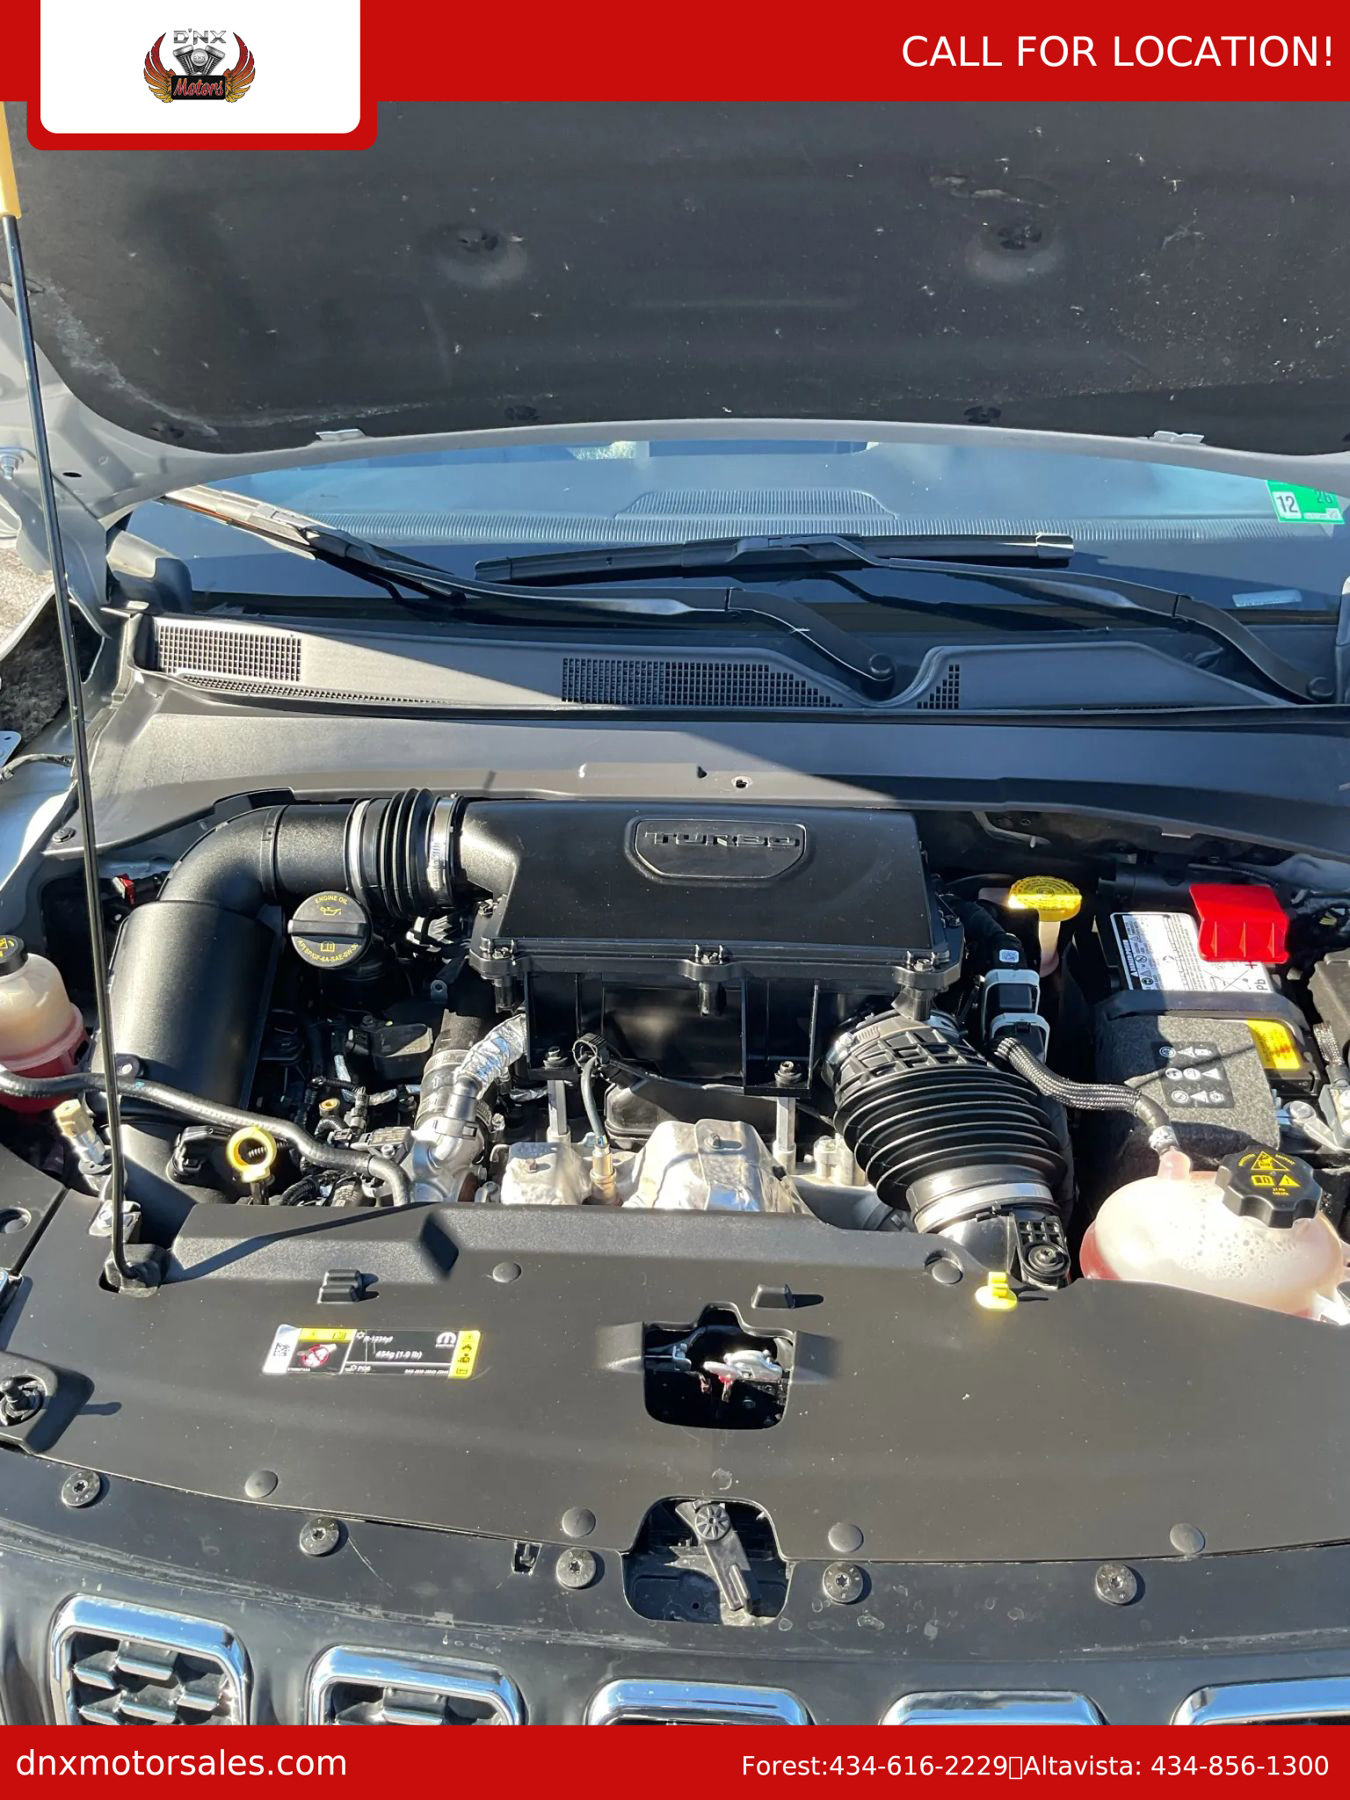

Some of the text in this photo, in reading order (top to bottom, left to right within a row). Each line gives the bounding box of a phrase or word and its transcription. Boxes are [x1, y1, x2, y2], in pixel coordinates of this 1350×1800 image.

[1276, 495, 1298, 513] 12
[644, 831, 801, 848] TURBO
[315, 895, 349, 905] ENGINE OIL
